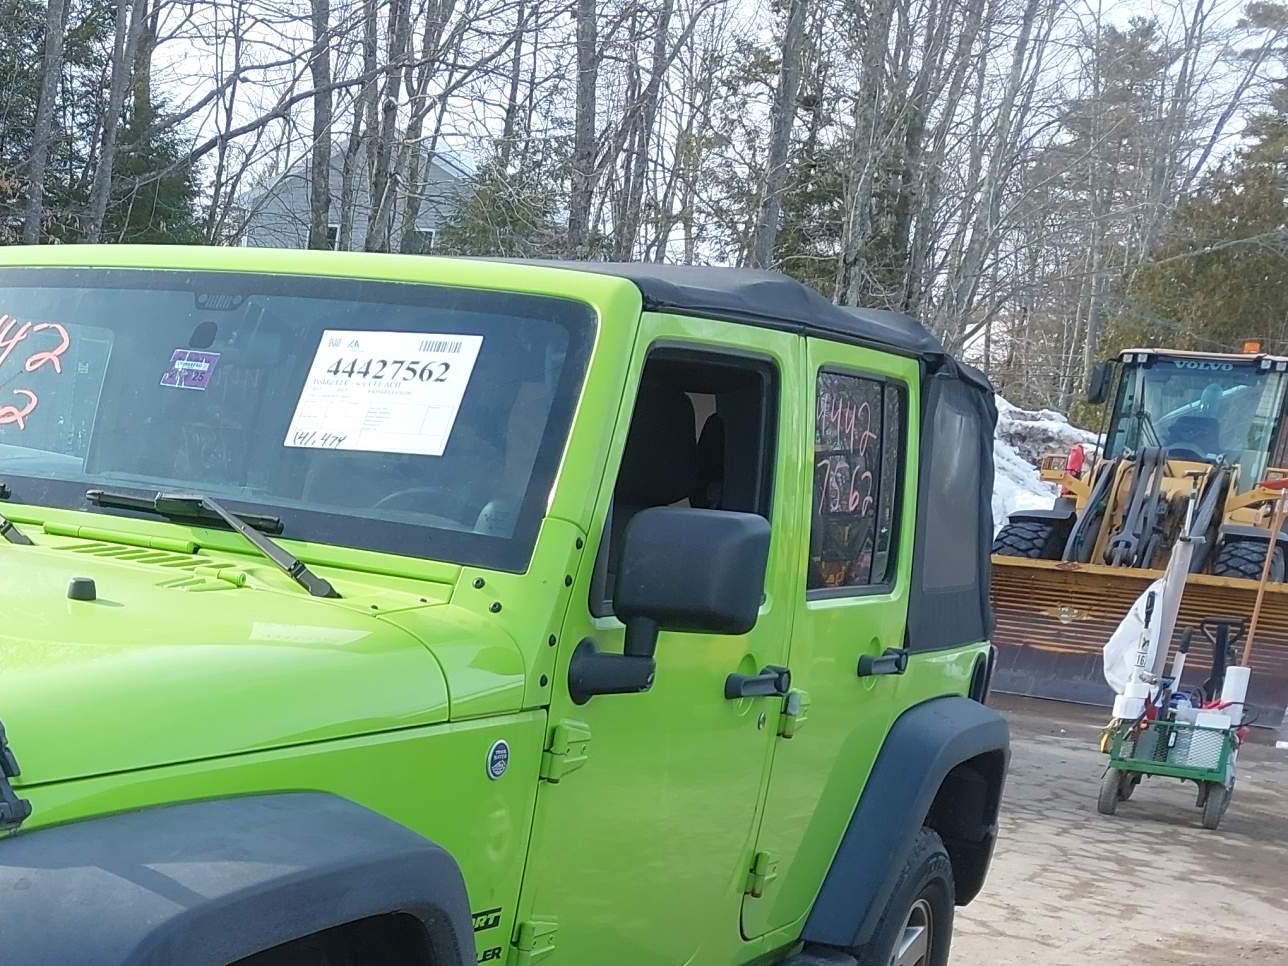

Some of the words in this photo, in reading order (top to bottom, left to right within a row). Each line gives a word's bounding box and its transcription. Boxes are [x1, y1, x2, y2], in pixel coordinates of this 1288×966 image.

[326, 357, 451, 383] 44427562
[1174, 360, 1233, 371] VOLVO
[817, 393, 877, 457] 4442
[817, 459, 874, 518] 7562
